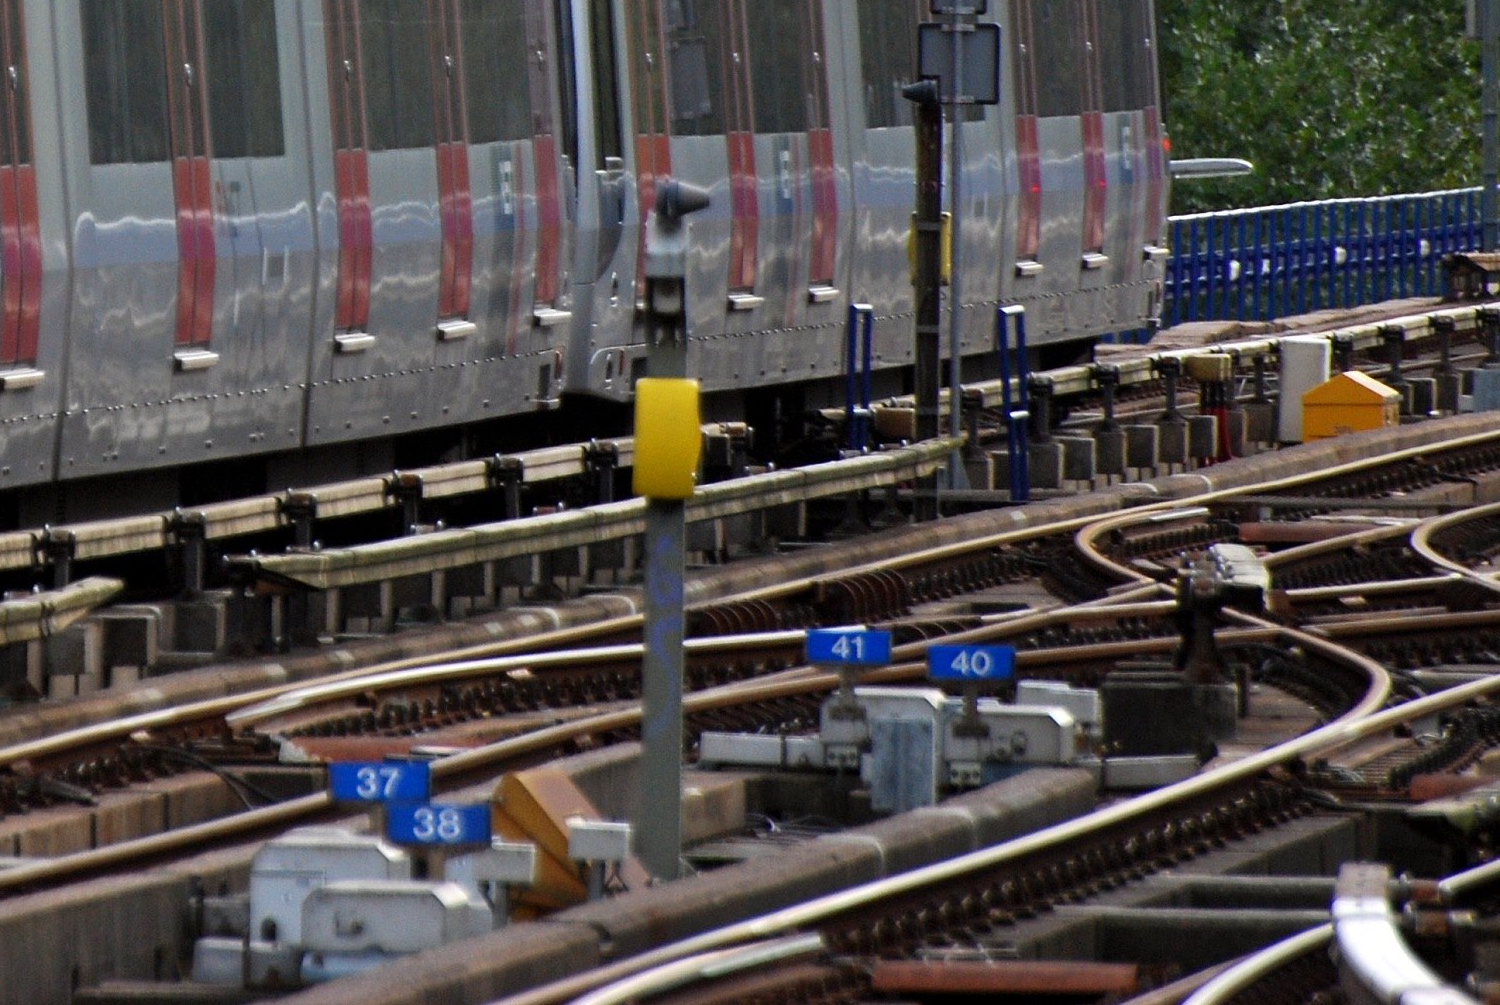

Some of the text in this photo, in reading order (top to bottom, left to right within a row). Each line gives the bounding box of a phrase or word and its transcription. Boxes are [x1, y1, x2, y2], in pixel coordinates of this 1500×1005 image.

[831, 635, 865, 659] 41
[950, 650, 991, 675] 40
[356, 767, 400, 798] 37
[413, 807, 461, 840] 38
